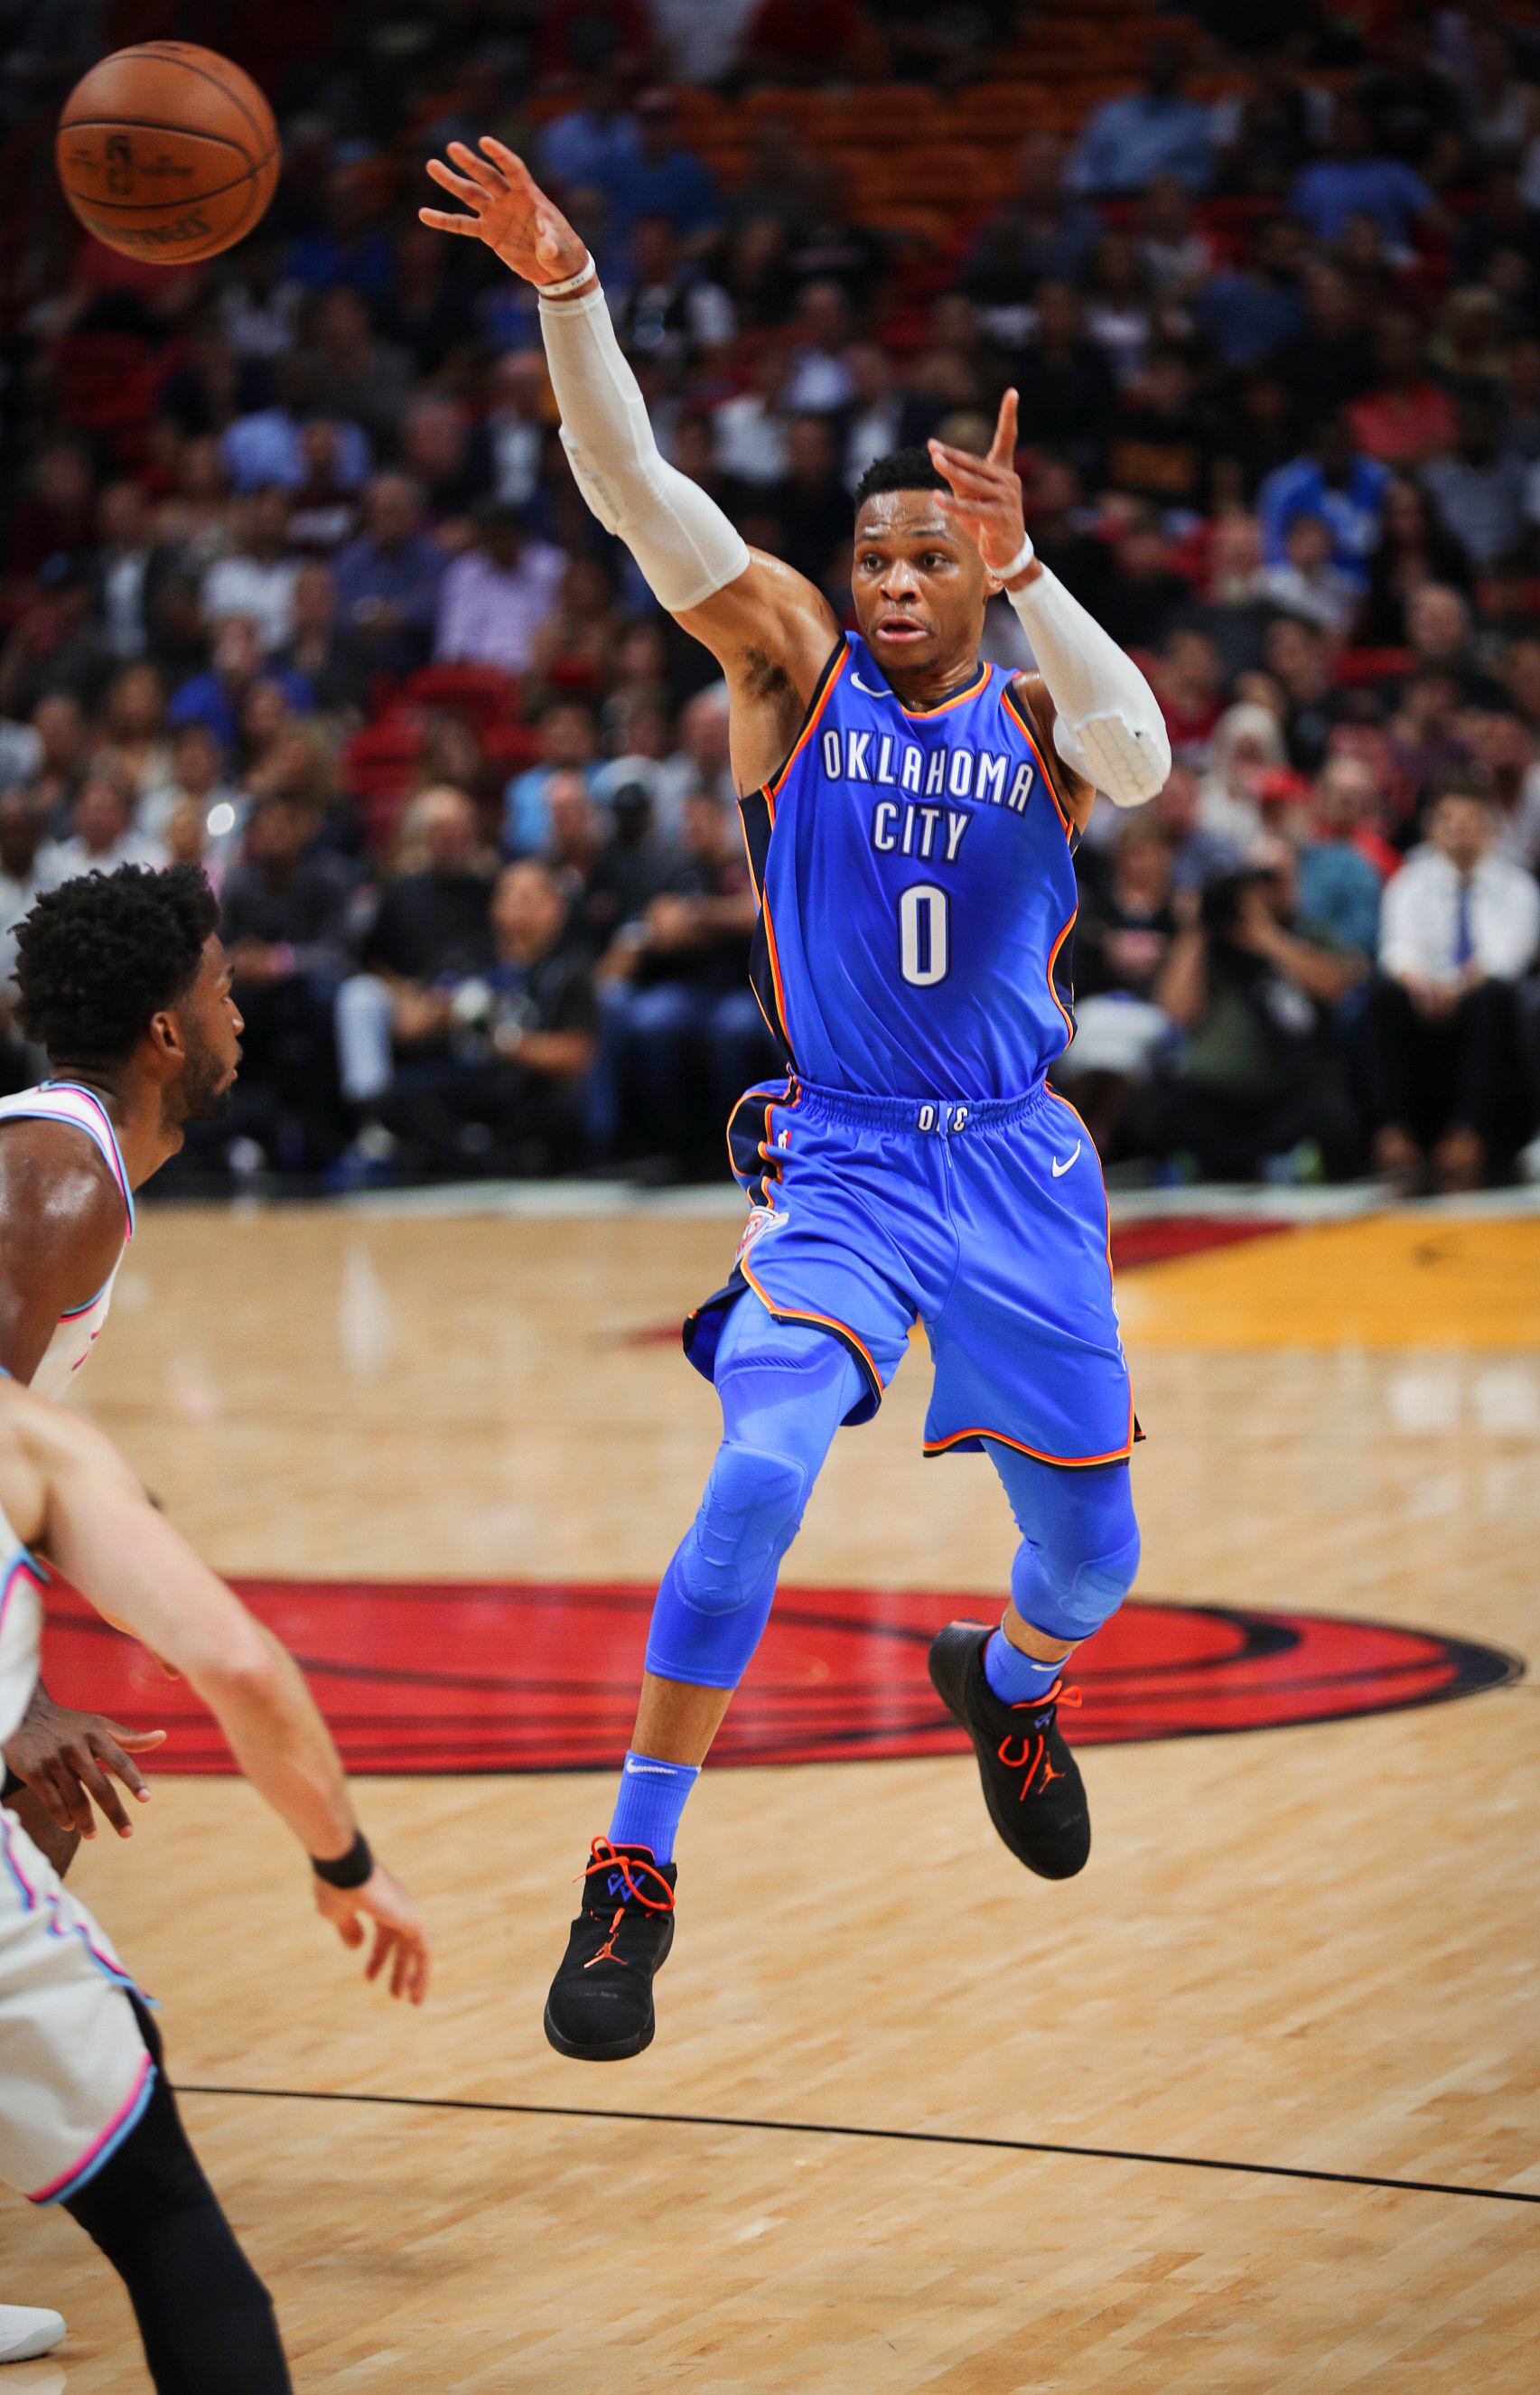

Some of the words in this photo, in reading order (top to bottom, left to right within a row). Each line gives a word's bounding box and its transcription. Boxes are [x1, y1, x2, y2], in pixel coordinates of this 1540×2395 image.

[823, 729, 1036, 816] OKLAHOMA
[873, 800, 972, 863] CITY
[899, 882, 951, 988] 0
